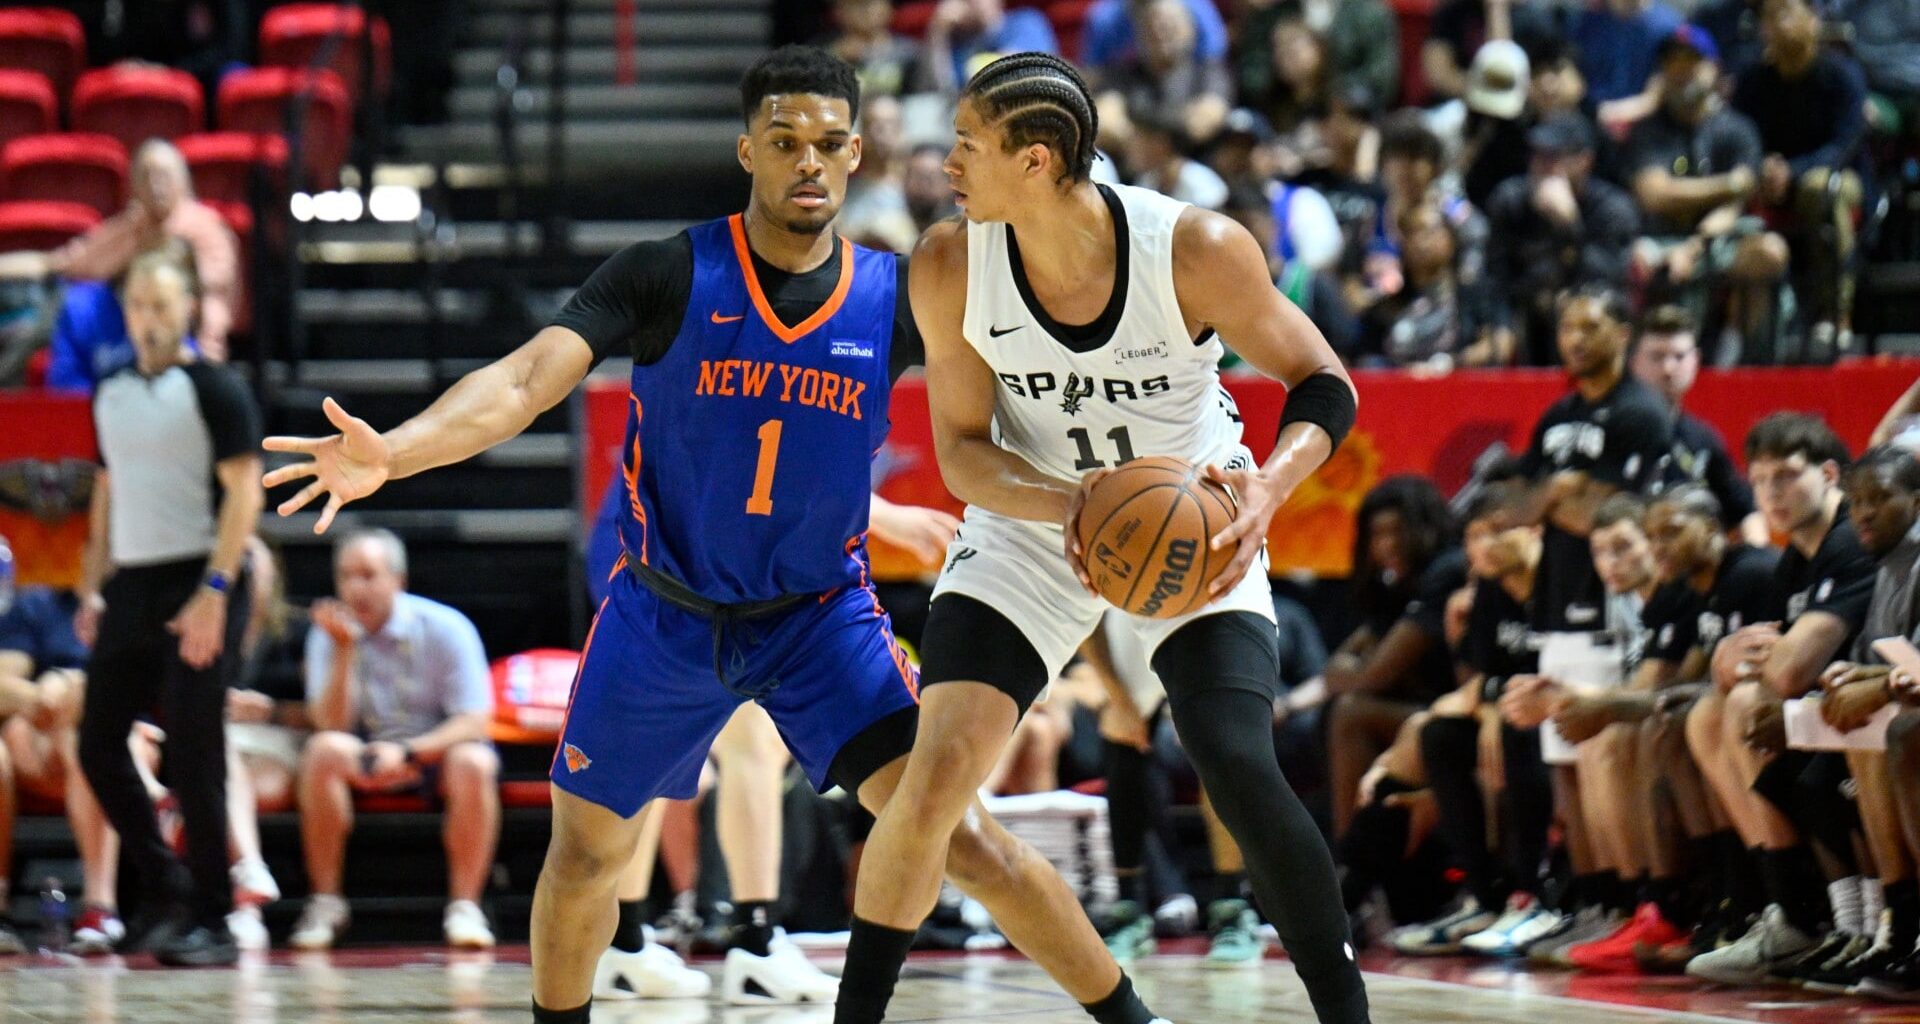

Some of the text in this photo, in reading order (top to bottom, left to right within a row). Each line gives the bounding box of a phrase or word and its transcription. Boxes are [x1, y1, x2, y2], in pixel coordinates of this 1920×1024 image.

[831, 346, 873, 358] abu dhabi
[1121, 346, 1160, 360] LEDGER
[695, 359, 866, 421] NEW YORK
[998, 371, 1171, 418] SPURS
[745, 419, 783, 516] 1
[1066, 425, 1144, 472] 11
